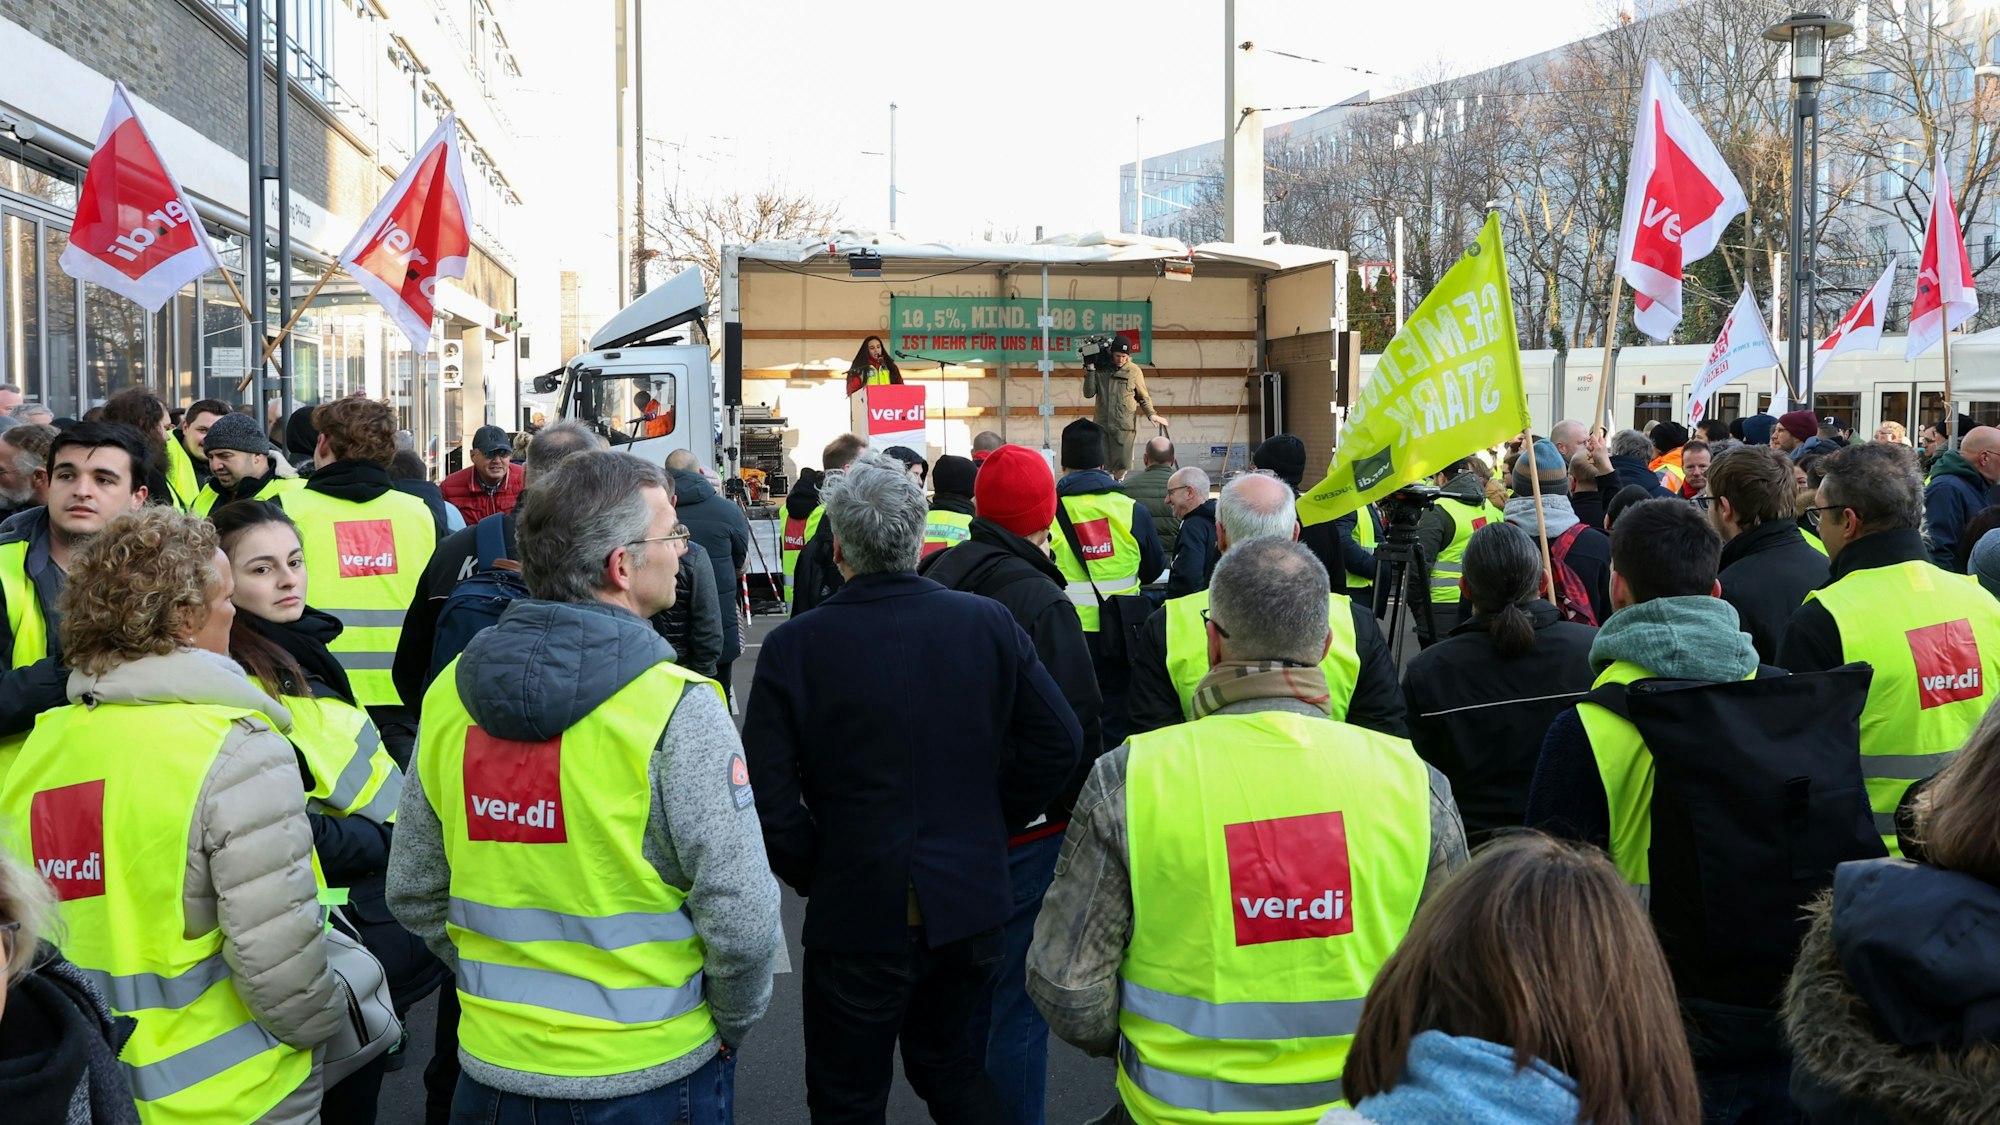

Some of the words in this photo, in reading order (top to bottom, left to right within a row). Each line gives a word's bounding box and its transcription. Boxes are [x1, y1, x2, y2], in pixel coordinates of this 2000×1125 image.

[902, 308, 966, 331] 10,5%,
[972, 306, 1031, 329] MIND.
[1037, 307, 1076, 330] 00
[1082, 308, 1095, 331] €
[1102, 313, 1143, 331] MEHR
[902, 334, 928, 350] IST
[932, 334, 967, 351] MEHR
[971, 332, 996, 351] FÜR
[1001, 336, 1026, 352] UNS
[871, 405, 925, 421] ver.di
[341, 552, 393, 567] ver.di
[1922, 668, 1979, 691] ver.di
[471, 795, 556, 829] ver.di
[38, 852, 101, 880] ver.di
[1240, 889, 1344, 920] ver.di
